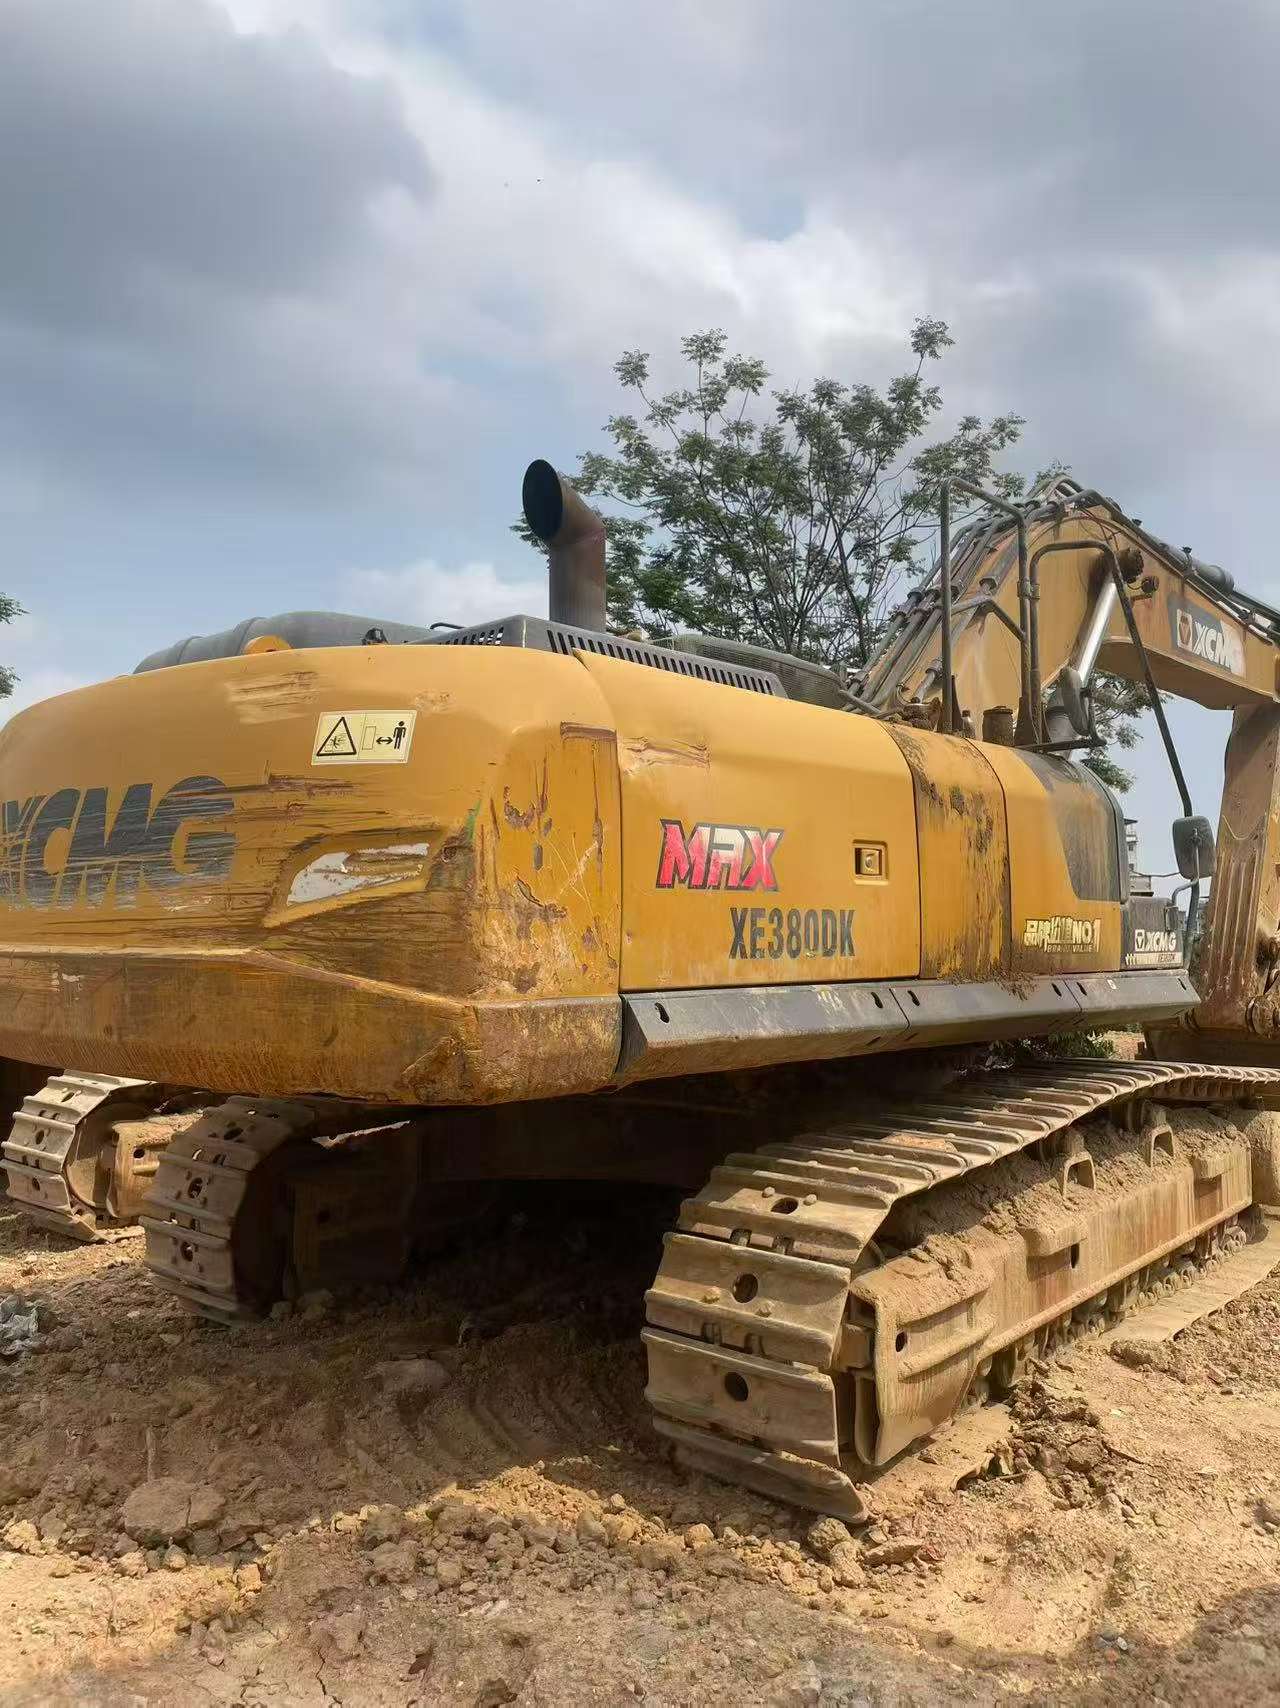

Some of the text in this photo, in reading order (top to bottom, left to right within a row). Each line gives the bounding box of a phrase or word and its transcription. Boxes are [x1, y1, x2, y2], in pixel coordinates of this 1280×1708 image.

[1192, 620, 1241, 674] XCM
[656, 819, 784, 891] MAX
[728, 907, 856, 960] XE380DK
[1144, 931, 1177, 952] XCMG
